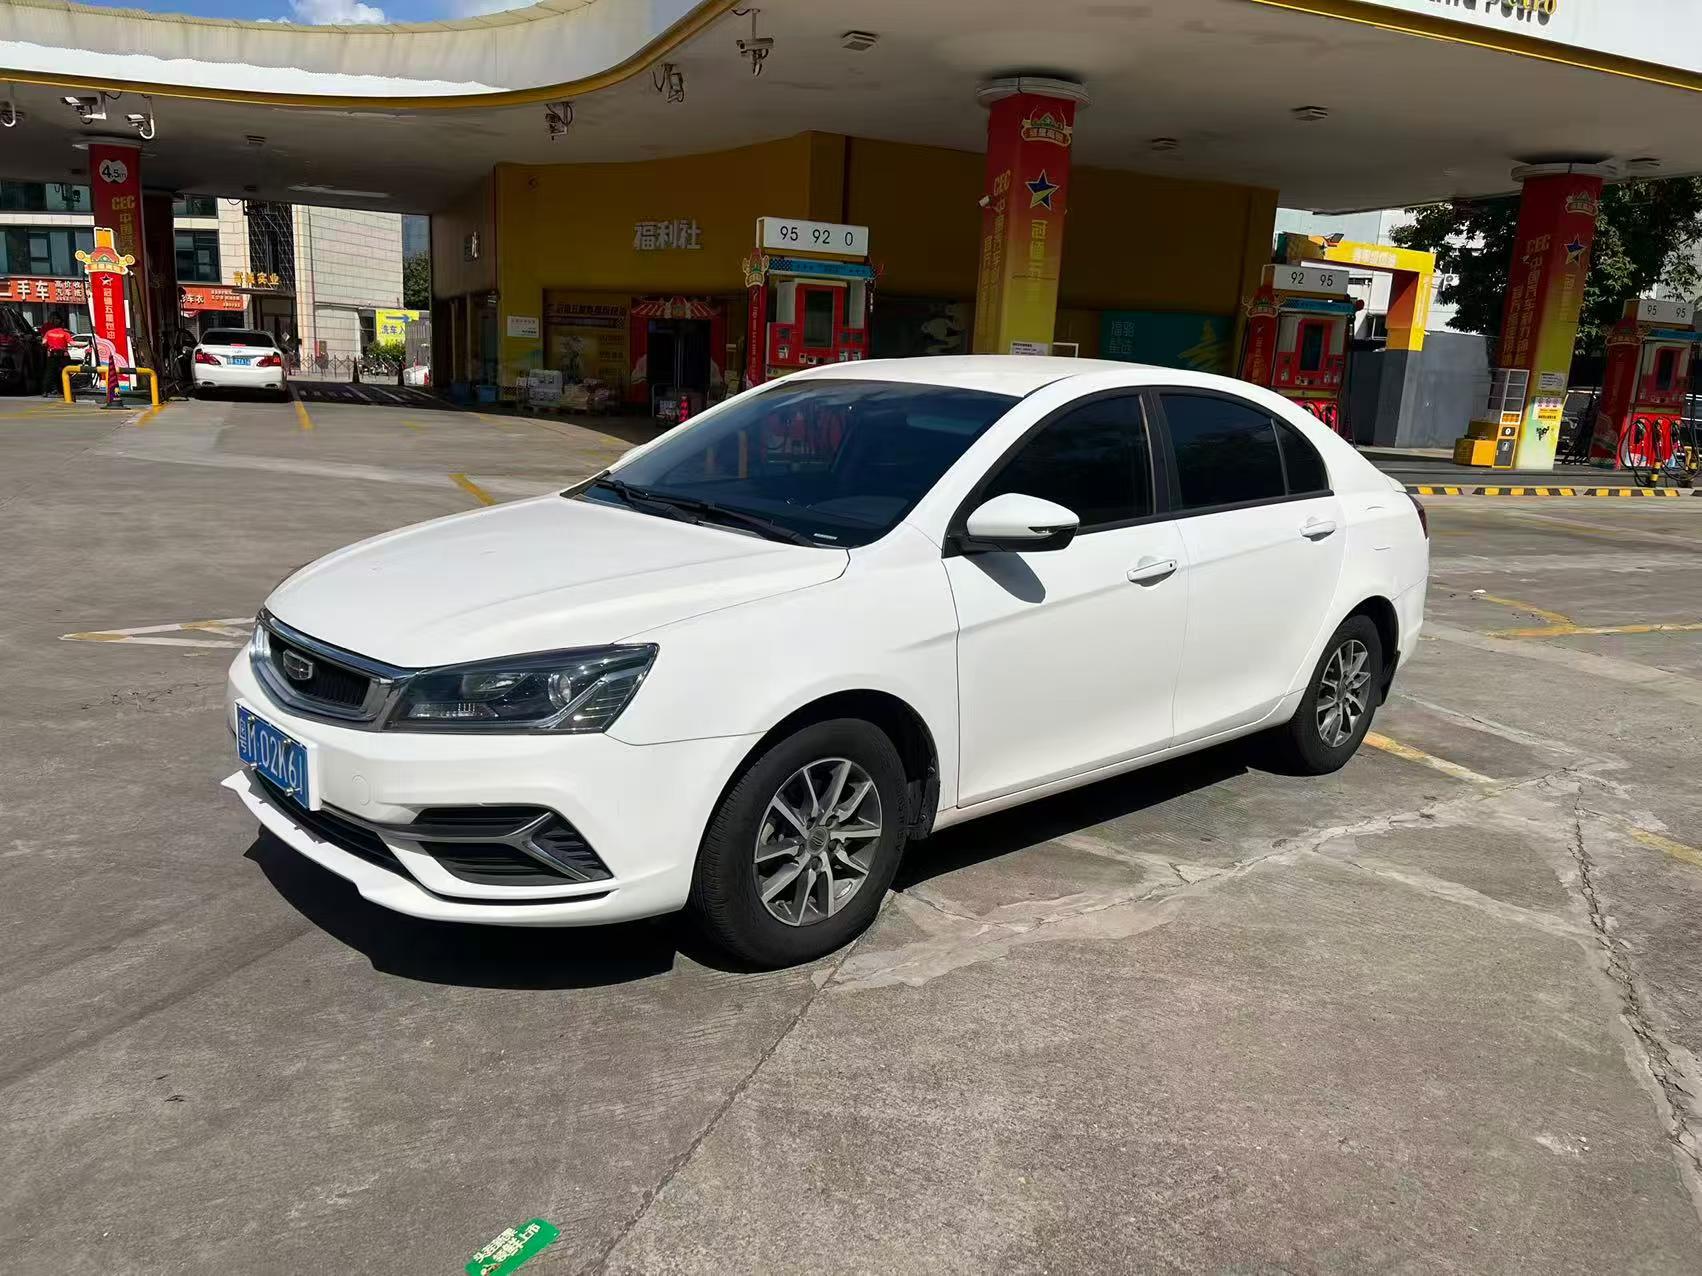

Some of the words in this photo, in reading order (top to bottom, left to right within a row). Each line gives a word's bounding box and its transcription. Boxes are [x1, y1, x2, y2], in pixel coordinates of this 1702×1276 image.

[112, 194, 136, 210] CEC
[632, 218, 703, 250] 福利社
[779, 225, 799, 241] 95
[812, 229, 830, 244] 92
[844, 231, 854, 246] 0
[1290, 271, 1305, 285] 92
[1320, 274, 1333, 287] 95
[1647, 305, 1657, 316] 95
[1676, 307, 1686, 318] 95
